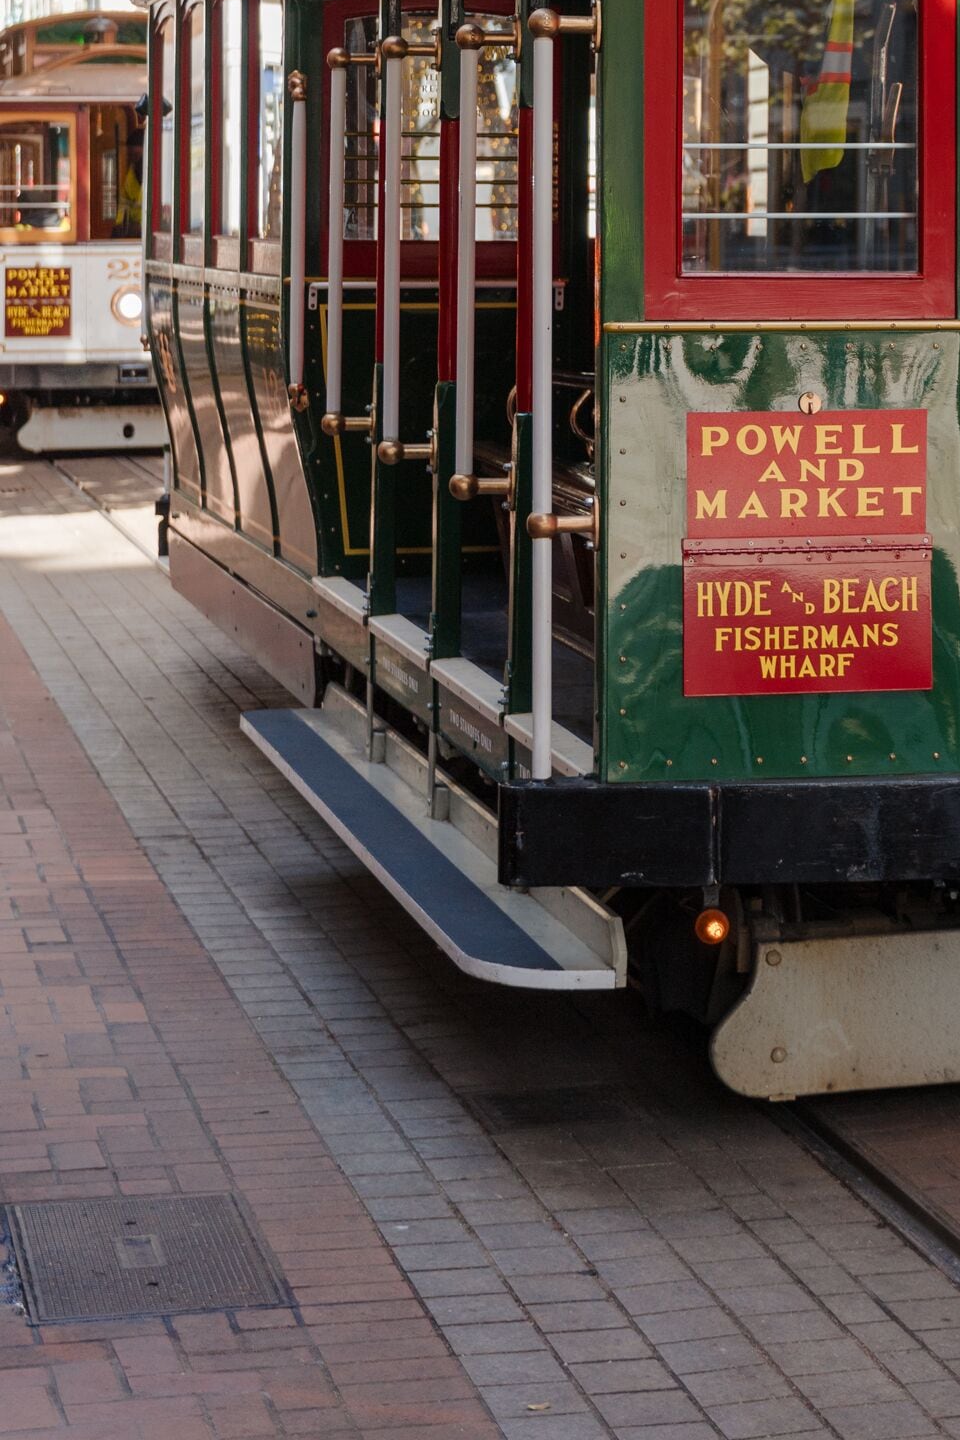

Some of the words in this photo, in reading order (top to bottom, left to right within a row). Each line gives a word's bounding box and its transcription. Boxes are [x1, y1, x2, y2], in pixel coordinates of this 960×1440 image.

[7, 269, 69, 281] POWELL
[24, 278, 54, 288] AND
[6, 285, 70, 297] MARKET
[700, 424, 919, 456] POWELL
[758, 458, 865, 483] AND
[695, 486, 922, 519] MARKET
[696, 580, 772, 617] HYDE
[780, 581, 816, 615] AND
[823, 576, 919, 615] BEACH
[714, 622, 899, 652] FISHERMANS
[758, 652, 855, 679] WHARF
[409, 675, 419, 693] ONLY
[450, 708, 460, 727] TWO
[481, 733, 492, 752] ONLY
